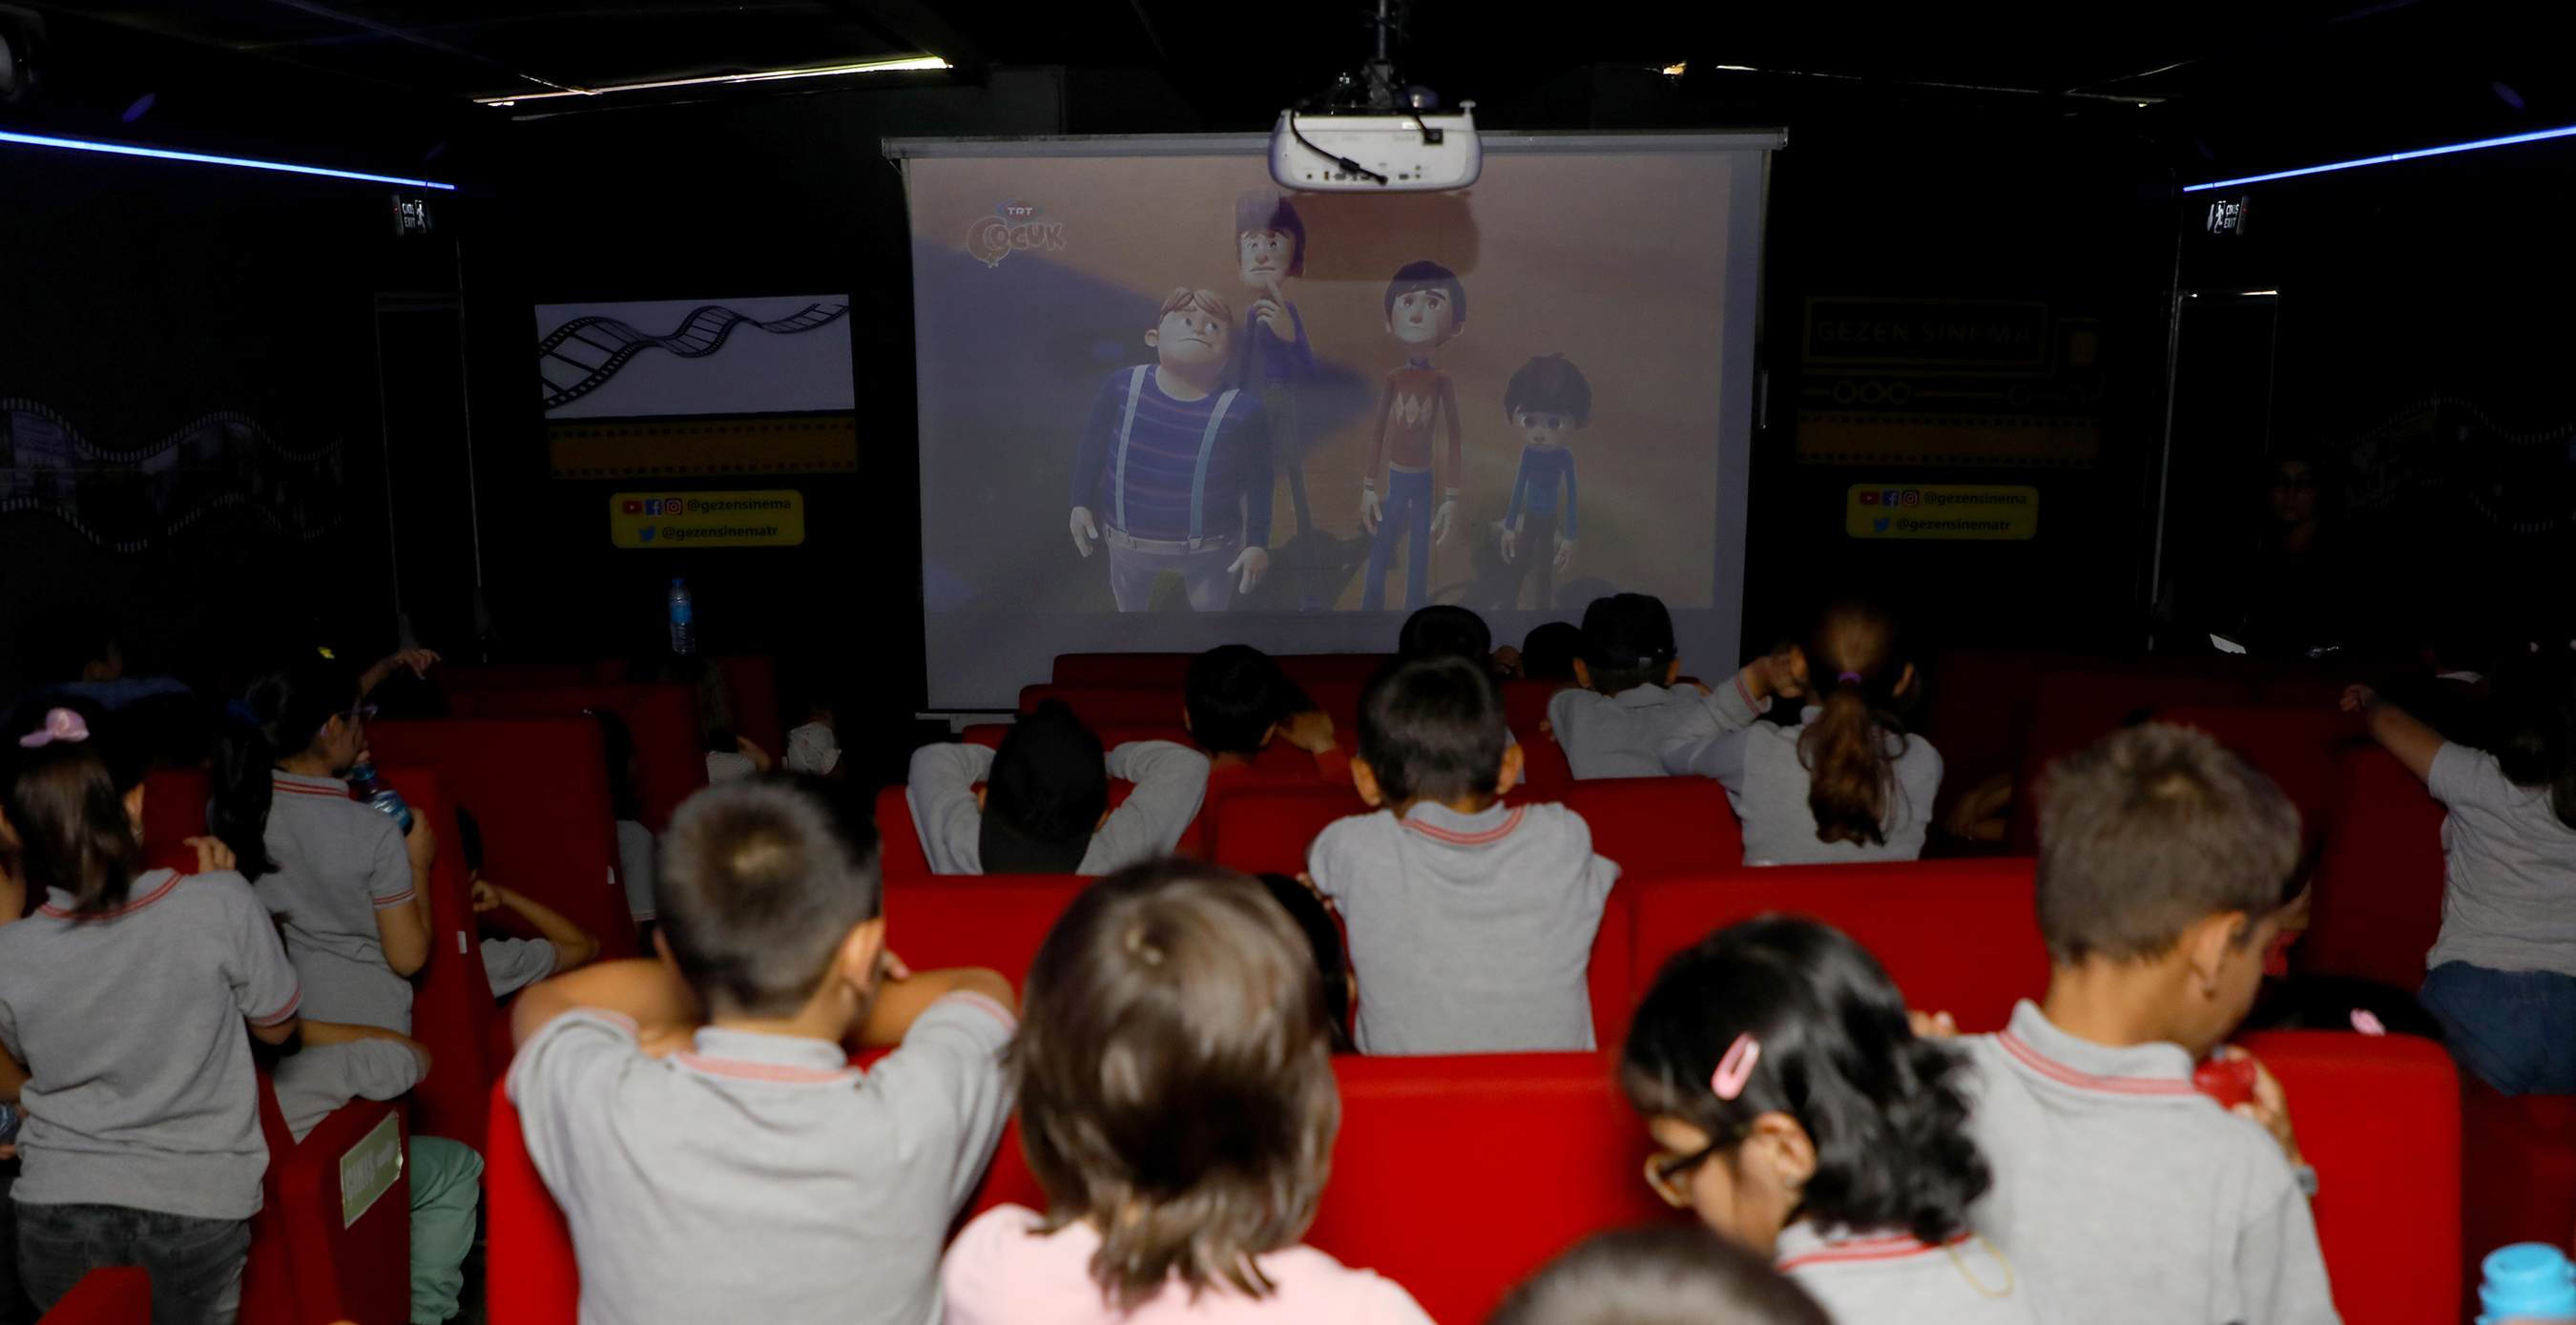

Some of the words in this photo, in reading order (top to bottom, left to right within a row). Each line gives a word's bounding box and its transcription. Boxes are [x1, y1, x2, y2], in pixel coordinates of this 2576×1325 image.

[1008, 207, 1034, 216] TRT
[1816, 321, 1909, 342] GEZEN
[687, 499, 791, 513] @gezensinema
[1923, 491, 2027, 507] @gezensinema
[1896, 518, 2011, 532] @gezensinematr
[662, 526, 779, 541] @gezensinematr
